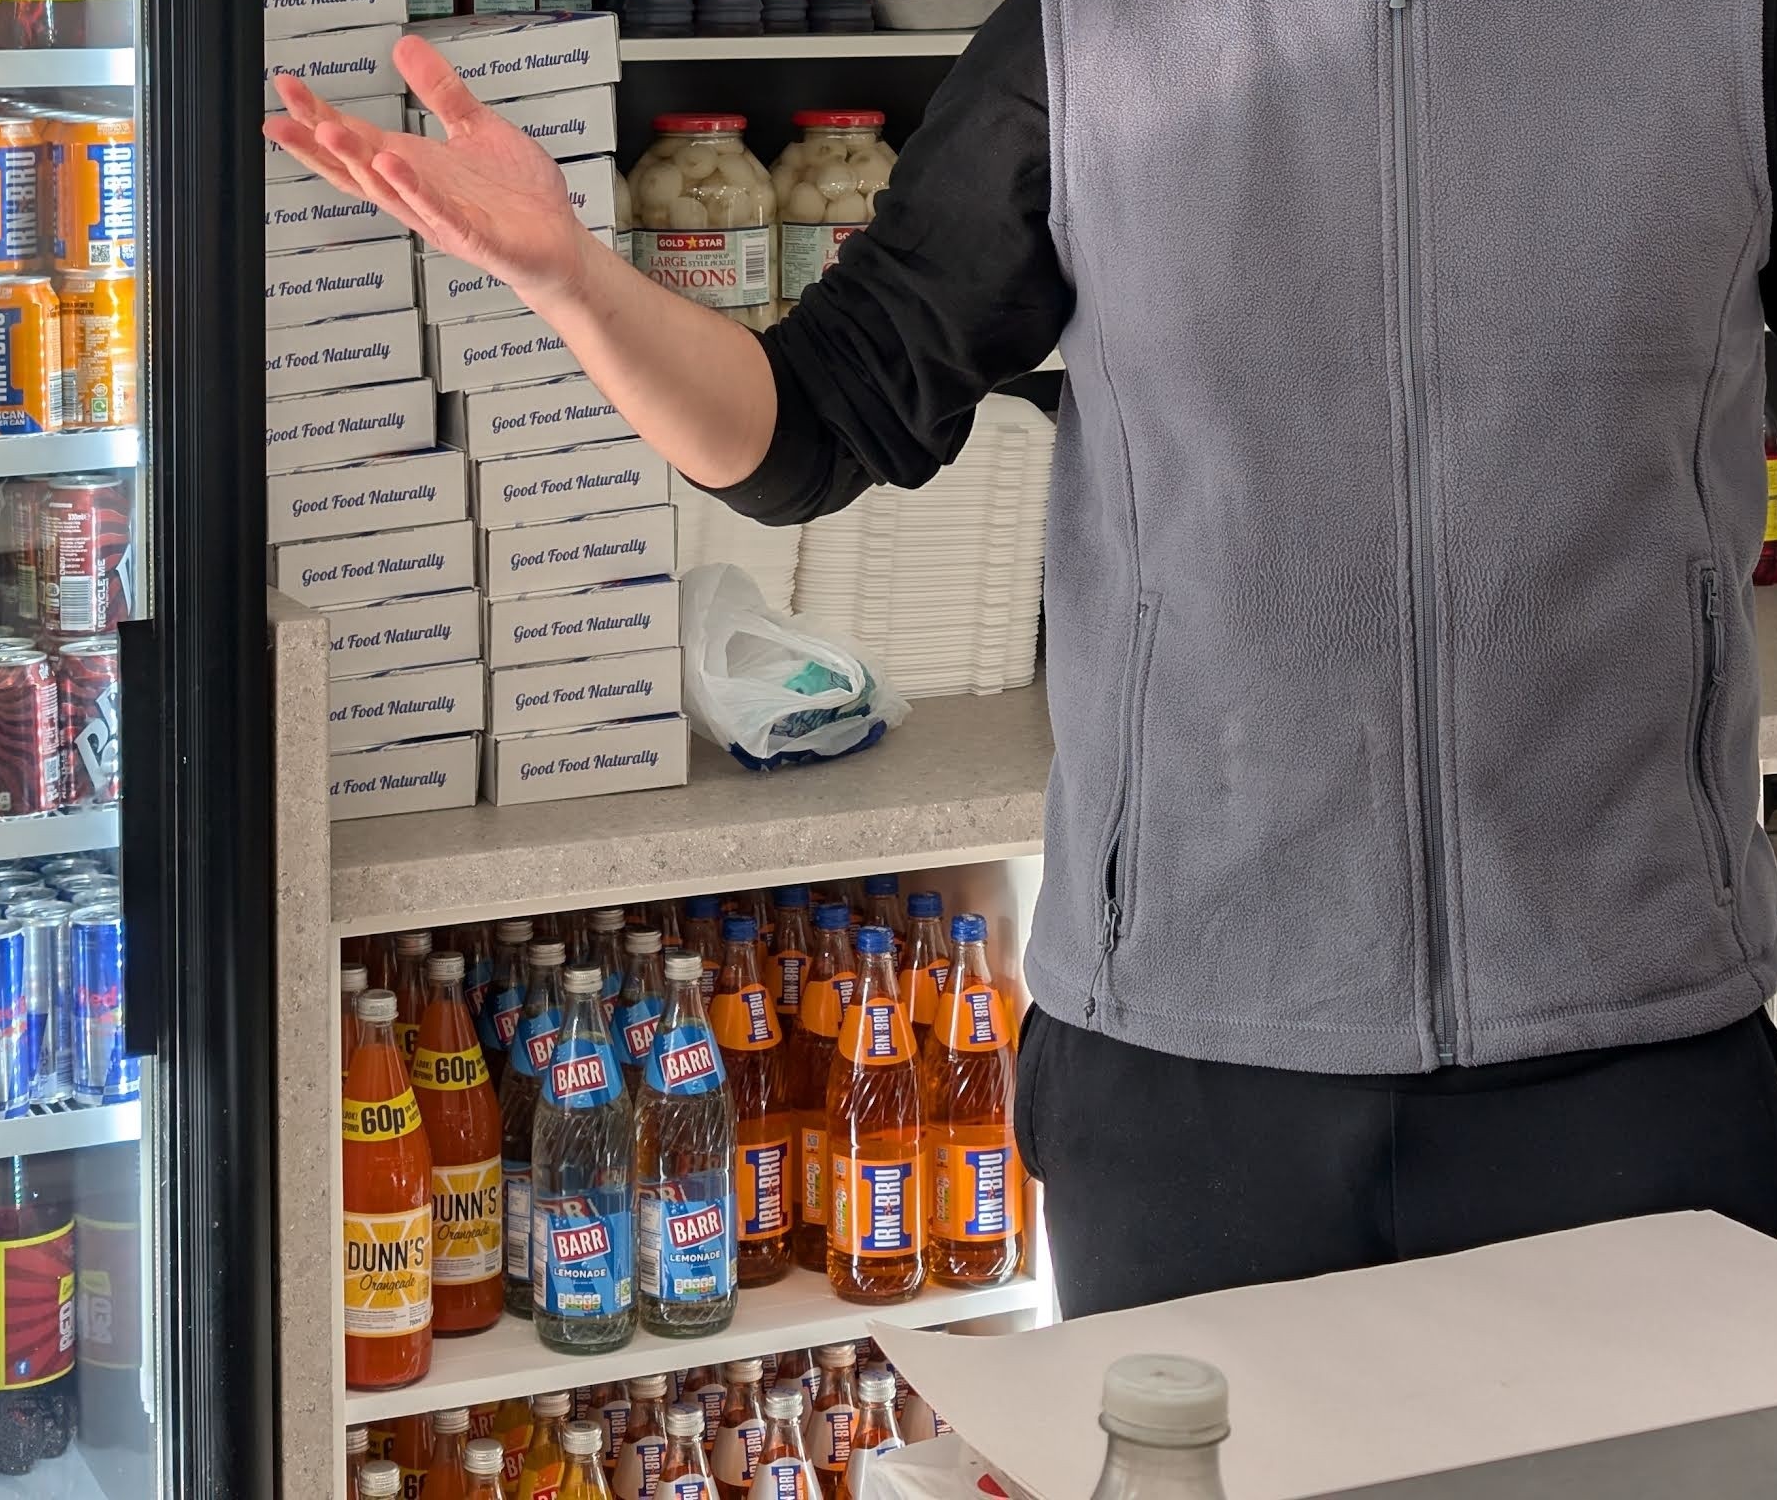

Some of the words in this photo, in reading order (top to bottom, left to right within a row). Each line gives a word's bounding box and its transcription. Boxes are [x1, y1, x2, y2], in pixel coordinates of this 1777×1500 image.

[659, 238, 684, 249] GOLD
[698, 237, 723, 248] STAR
[713, 252, 729, 261] SHOP
[650, 255, 687, 267] LARGE
[688, 259, 709, 267] STYLE
[278, 280, 312, 296] Food
[315, 272, 385, 293] Naturally
[648, 268, 737, 288] ONIONS
[463, 346, 497, 366] Good
[501, 341, 533, 359] Food
[10, 418, 26, 427] CAN
[492, 414, 526, 433] Good
[530, 409, 562, 428] Food
[503, 480, 537, 499] Good
[540, 476, 573, 494] Food
[576, 468, 641, 489] Naturally
[292, 498, 328, 517] Good
[332, 493, 365, 511] Food
[369, 484, 437, 505] Naturally
[98, 559, 105, 573] ME
[511, 551, 544, 570] Good
[547, 546, 580, 564] Food
[584, 538, 647, 559] Naturally
[302, 567, 338, 586] Good
[341, 561, 375, 580] Food
[378, 553, 445, 574] Naturally
[98, 578, 106, 628] RECYCLE
[348, 632, 381, 650] Food
[385, 623, 452, 644] Naturally
[514, 625, 548, 643] Good
[551, 619, 584, 637] Food
[587, 612, 651, 633] Naturally
[516, 692, 550, 711] Good
[553, 687, 585, 705] Food
[588, 679, 653, 700] Naturally
[521, 763, 555, 780] Good
[558, 756, 591, 775] Food
[594, 749, 659, 770] Naturally
[343, 777, 376, 794] Food
[379, 770, 446, 790] Naturally
[77, 986, 118, 1007] Red
[435, 1056, 477, 1086] 60p
[555, 1060, 603, 1094] BARR
[666, 1046, 713, 1082] BARR
[360, 1104, 406, 1135] 60p
[673, 1209, 721, 1245] BARR
[348, 1236, 424, 1272] DUNN'S
[556, 1229, 606, 1258] BARR
[669, 1250, 722, 1263] LEMONADE
[360, 1274, 415, 1296] Orangeade
[553, 1267, 607, 1278] LEMONADE
